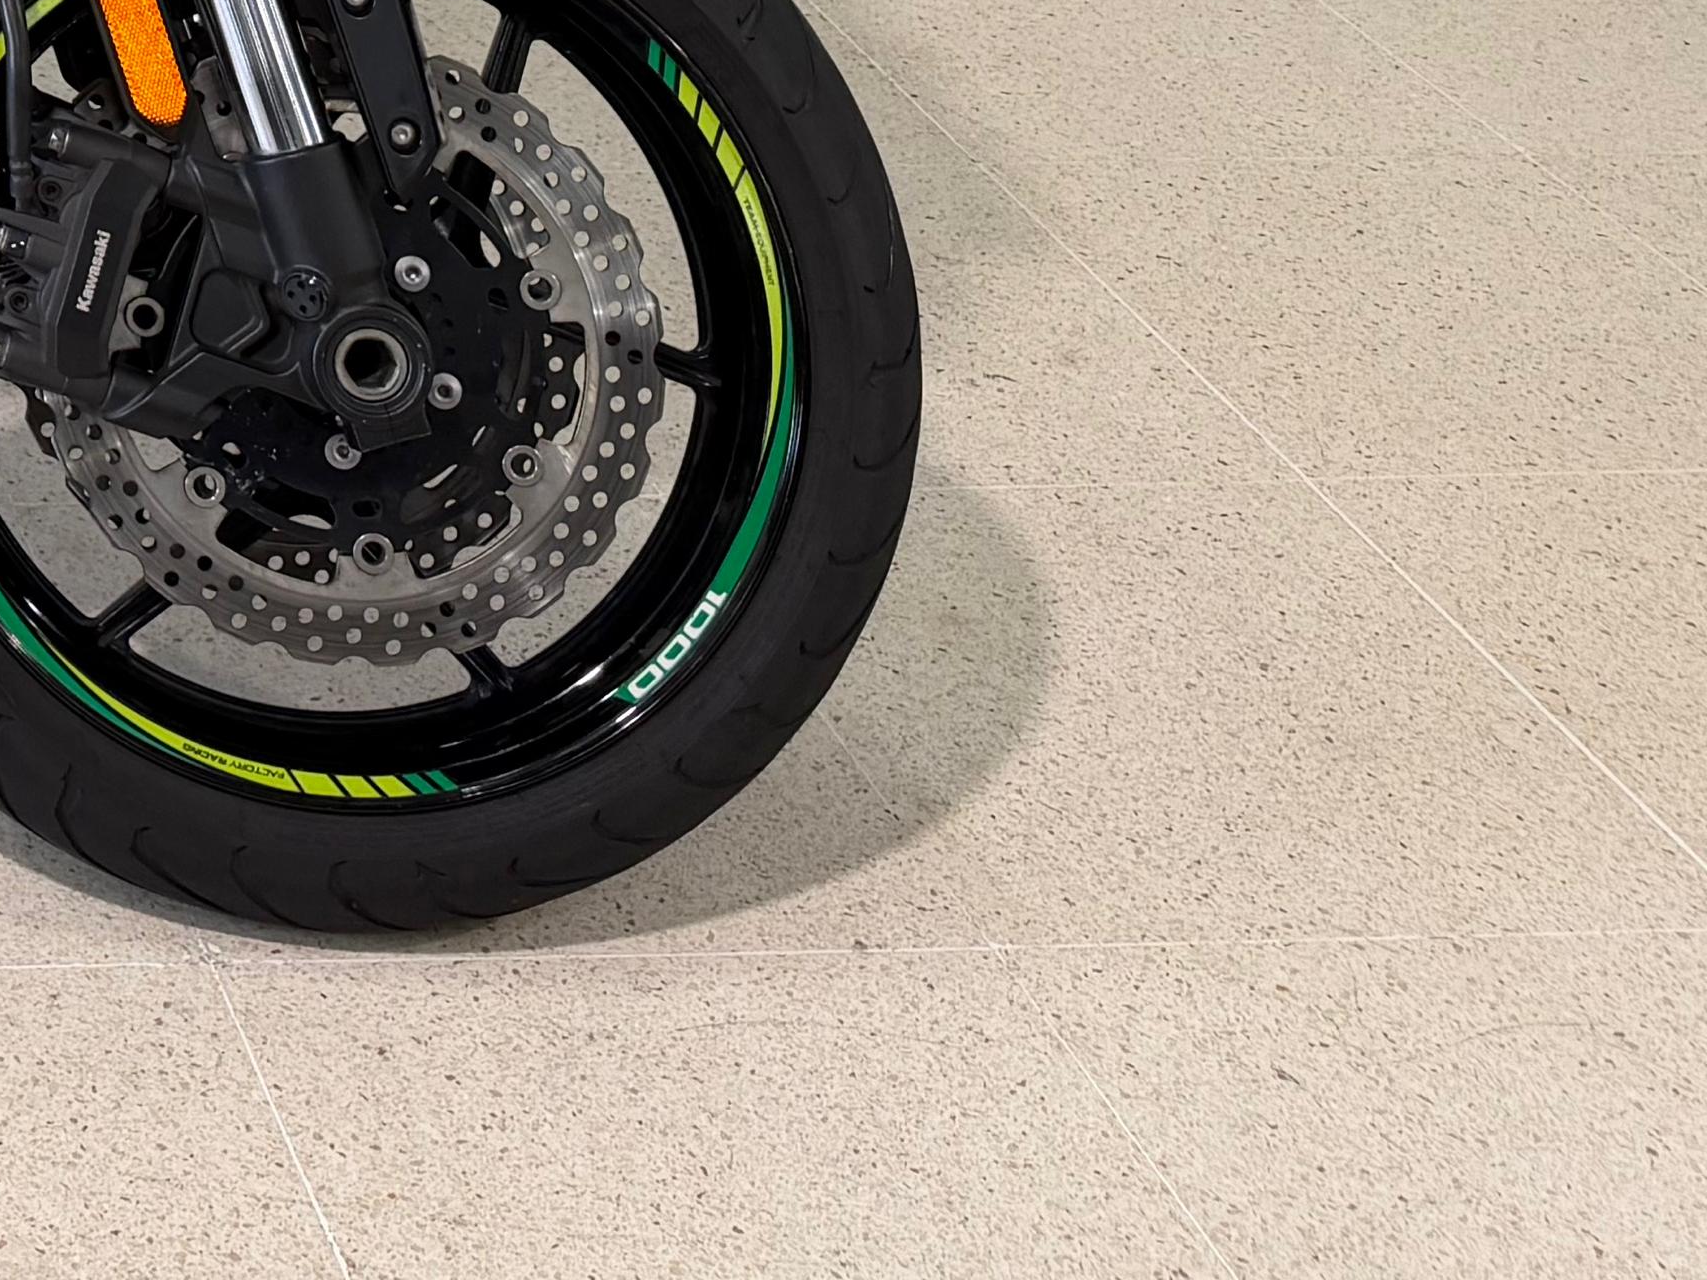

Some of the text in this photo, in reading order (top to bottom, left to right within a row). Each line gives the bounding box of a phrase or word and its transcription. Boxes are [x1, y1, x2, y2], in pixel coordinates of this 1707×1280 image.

[75, 229, 112, 313] Kawasaki
[627, 590, 727, 699] 1000
[183, 742, 285, 780] FACTORY RACING
